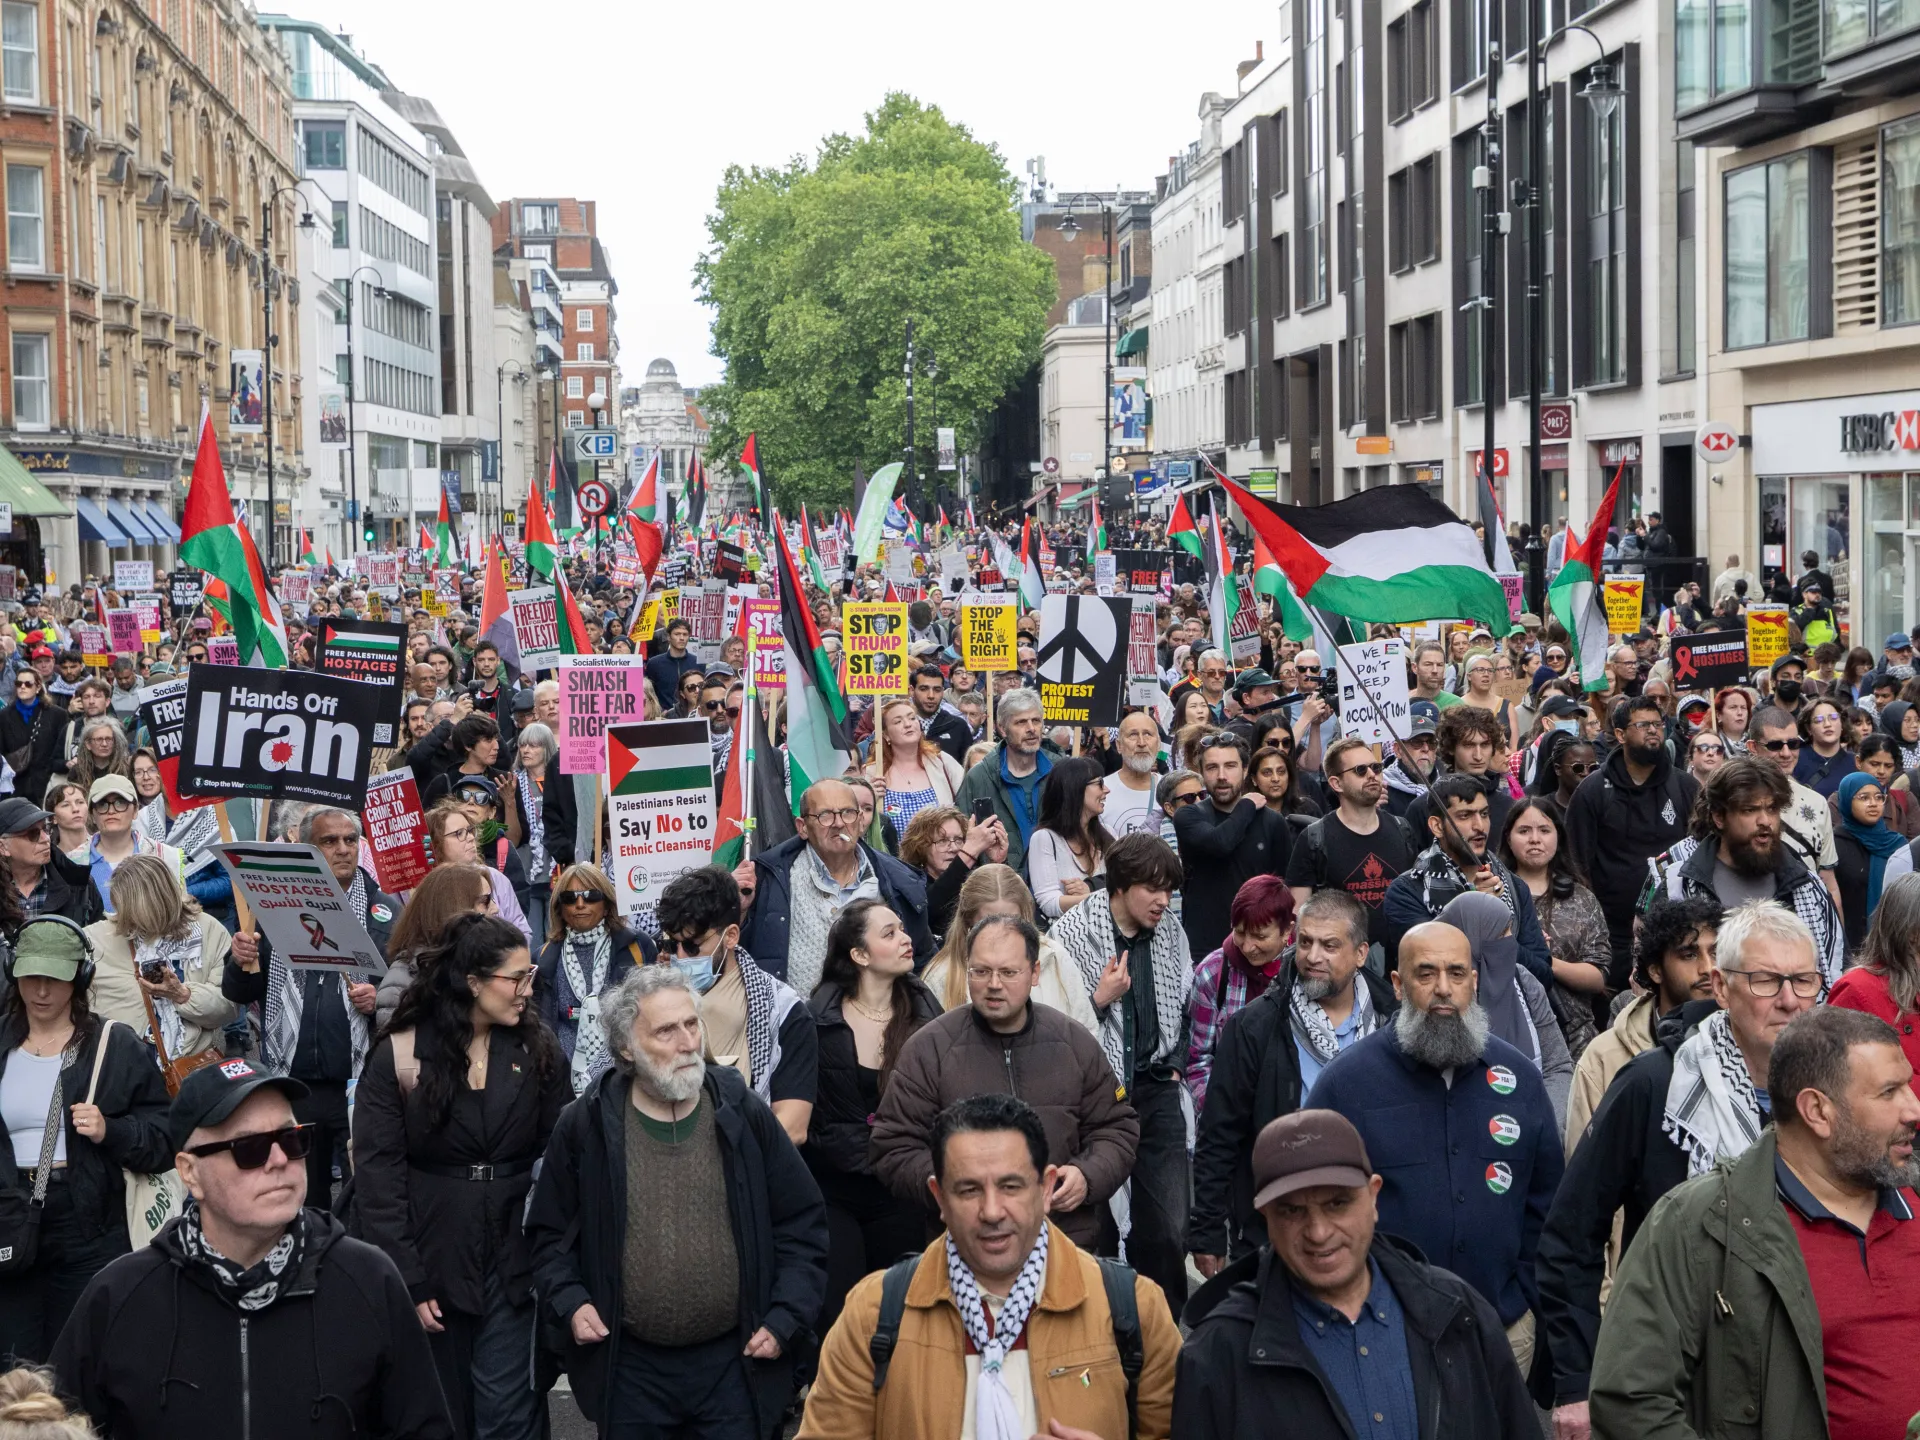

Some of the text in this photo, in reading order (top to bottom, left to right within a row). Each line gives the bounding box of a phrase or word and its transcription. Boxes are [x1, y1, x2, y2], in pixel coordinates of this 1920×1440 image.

[1547, 417, 1563, 428] PRET
[1839, 411, 1895, 453] HSBC
[1132, 570, 1158, 585] FREE
[174, 582, 199, 590] STOP
[1507, 588, 1520, 596] FAR
[1608, 597, 1630, 605] Together
[111, 615, 133, 623] SMASH
[513, 600, 557, 627] FREEDO
[970, 607, 1003, 618] STOP
[1626, 612, 1637, 620] right
[849, 614, 901, 636] STOP
[970, 620, 994, 631] THE
[1752, 628, 1777, 636] Together
[114, 631, 132, 639] RIGHT
[970, 632, 993, 643] FAR
[850, 636, 901, 651] TRUMP
[970, 644, 1009, 656] RIGHT
[1692, 641, 1745, 654] FREE PALESTINIAN
[325, 650, 398, 661] FREE PALESTINIAN
[1129, 643, 1157, 674] PALESTINE
[1362, 647, 1380, 660] WE
[1693, 650, 1745, 667] HOSTAGES
[324, 658, 397, 673] HOSTAGES
[849, 653, 901, 674] STOP
[1357, 661, 1390, 675] DON'T
[568, 671, 627, 691] SMASH
[763, 674, 777, 682] FAR
[850, 675, 901, 689] FARAGE
[1042, 684, 1095, 697] PROTEST
[229, 686, 339, 716] Hands Off
[568, 694, 635, 714] THE FAR
[1042, 696, 1065, 707] AND
[194, 691, 361, 782] Iran
[204, 779, 220, 788] Stop
[220, 780, 230, 788] the
[245, 783, 273, 791] coalition
[285, 784, 352, 800] www.stopwar.org.uk
[380, 785, 404, 802] NOT A
[616, 794, 707, 812] Palestinians Resist
[366, 800, 404, 823] CRIME TO
[370, 811, 421, 838] ACT AGAINST
[619, 812, 708, 840] Say No to
[374, 829, 415, 852] GENOCIDE
[620, 838, 712, 857] Ethnic Cleansing
[383, 854, 394, 863] Free
[240, 874, 328, 885] FREE PALESTINIAN
[1347, 879, 1393, 890] massiv
[246, 882, 335, 897] HOSTAGES
[259, 897, 343, 911] الحرية للأسرى
[220, 1061, 246, 1073] FCK
